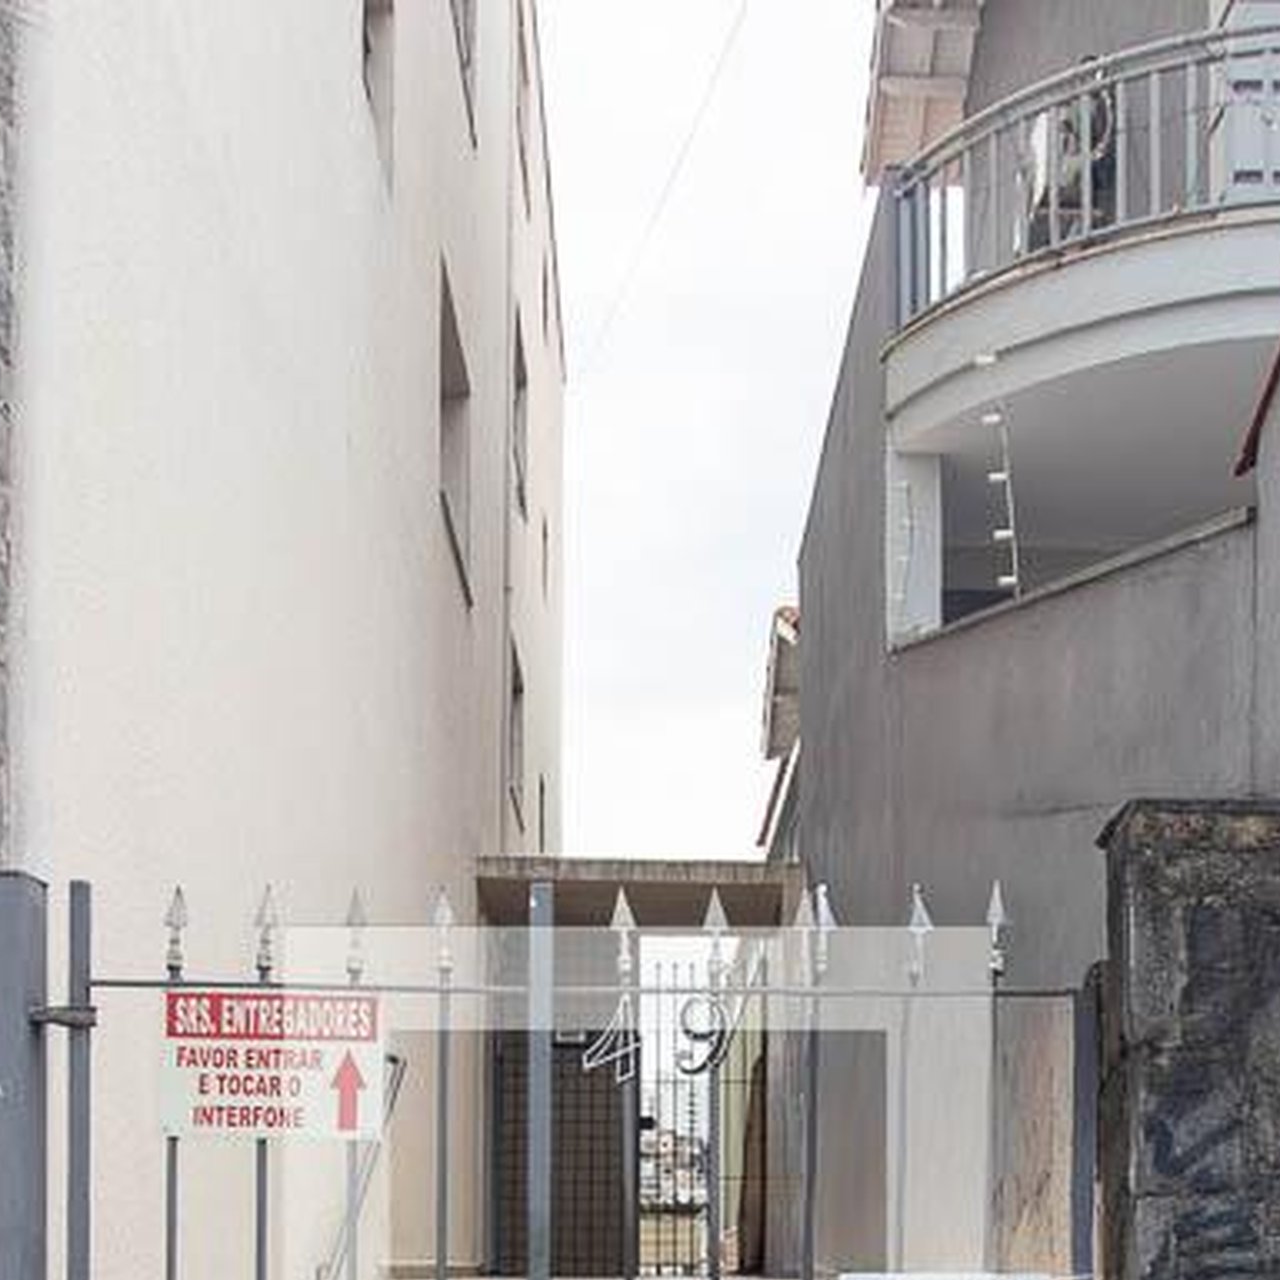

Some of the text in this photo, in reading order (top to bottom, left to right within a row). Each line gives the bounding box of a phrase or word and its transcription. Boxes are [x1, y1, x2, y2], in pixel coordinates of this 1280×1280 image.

[220, 998, 373, 1039] ENTREGADORES
[176, 1048, 322, 1071] FAVOR ENTRAR
[199, 1075, 302, 1097] E TOCAR O
[192, 1105, 306, 1129] INTERFONE
